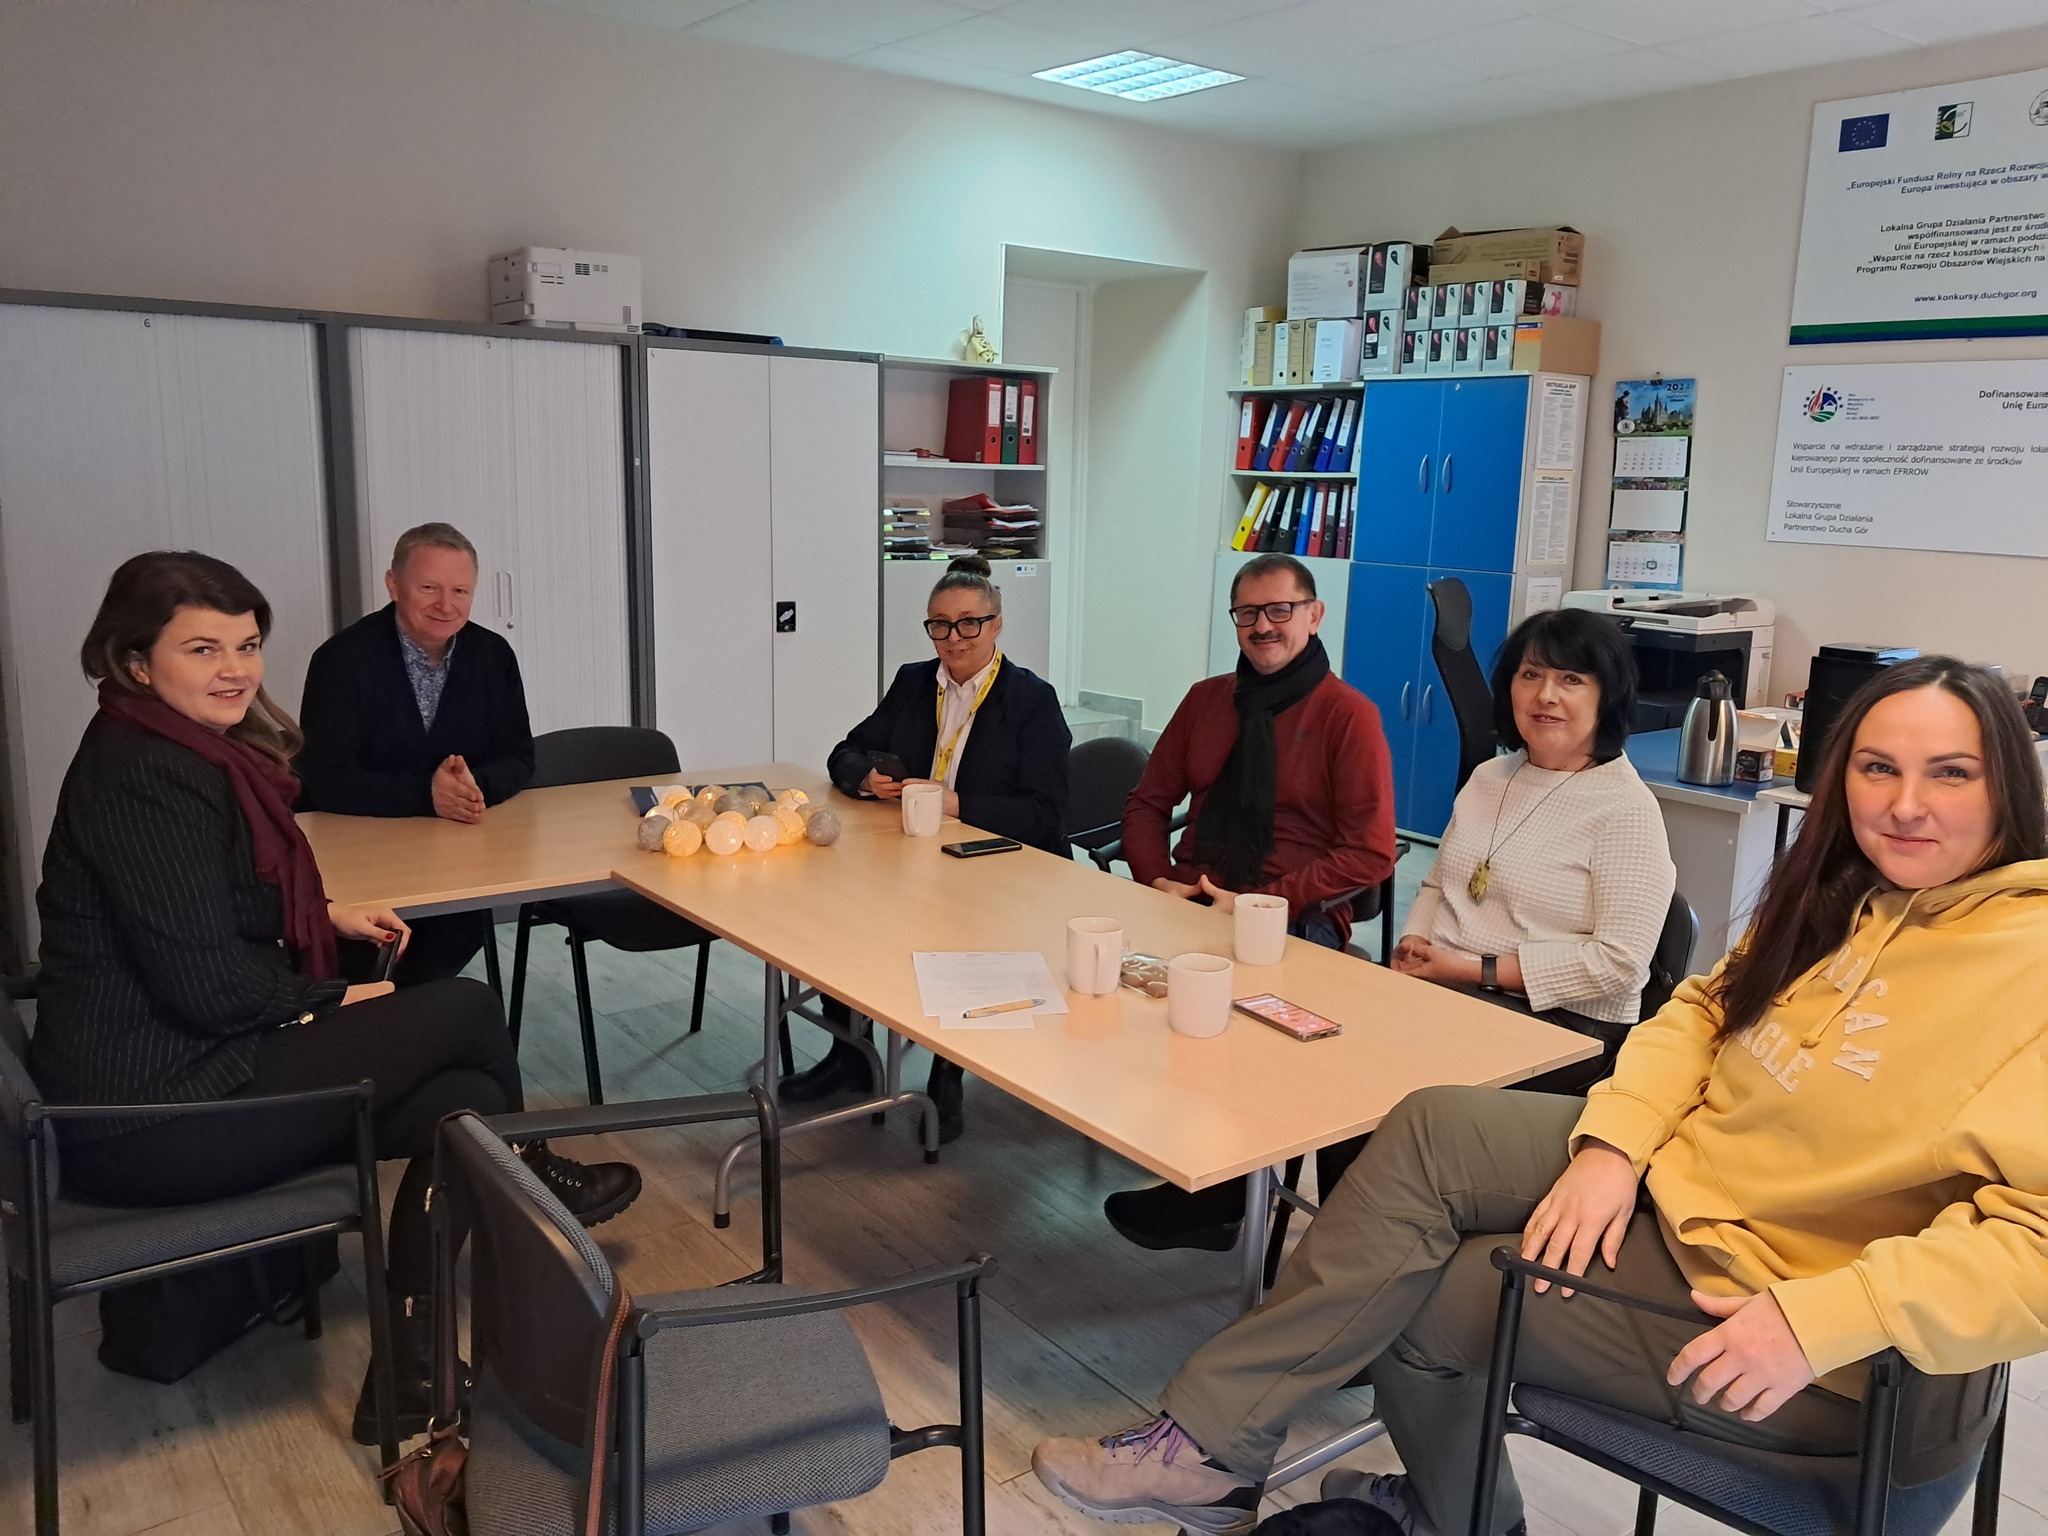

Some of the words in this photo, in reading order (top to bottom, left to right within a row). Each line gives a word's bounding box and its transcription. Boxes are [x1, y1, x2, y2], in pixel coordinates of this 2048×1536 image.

[1897, 174, 1934, 184] Fundusz
[1936, 172, 1962, 181] Rolny
[1978, 166, 2007, 176] Rzecz
[1901, 184, 1932, 194] Europa
[1934, 179, 1988, 190] inwestująca
[2000, 174, 2038, 184] obszary
[1880, 224, 1914, 232] Lokalna
[1916, 221, 1942, 230] Grupa
[1946, 216, 1986, 227] Działania
[1988, 212, 2046, 224] Partnerstwo
[1908, 226, 1989, 240] współfinansowana
[1991, 226, 2009, 235] jest
[1914, 238, 1968, 250] Europejskiej
[1980, 236, 2014, 244] ramach
[1953, 248, 1990, 257] kosztów
[1992, 244, 2040, 254] bieżących
[1856, 264, 1898, 274] Programu
[1900, 262, 1937, 270] Rozwoju
[1940, 258, 1984, 268] Obszarów
[1986, 255, 2032, 266] Wiejskich
[1914, 290, 2038, 302] www.konkursy.duchgor.org
[2002, 400, 2024, 411] Unię
[1792, 442, 1826, 452] Wsparcie
[1844, 443, 1884, 451] wdrażanie
[1896, 444, 1944, 453] zarządzanie
[1948, 444, 1986, 454] strategią
[1990, 445, 2025, 454] rozwoju
[1792, 454, 1838, 464] kierowanego
[1862, 454, 1908, 464] społeczność
[1911, 456, 1972, 464] dofinansowane
[1986, 457, 2022, 466] środków
[1806, 466, 1851, 476] Europejskiej
[1862, 467, 1891, 475] ramach
[1893, 467, 1930, 476] EFRROW
[1786, 500, 1842, 510] Stowarzyszenie
[1784, 512, 1812, 520] Lokalna
[1814, 512, 1837, 522] Grupa
[1838, 514, 1874, 523] Działania
[1784, 523, 1826, 532] Partnerstwo
[1828, 525, 1852, 534] Ducha
[1854, 526, 1869, 534] Gór
